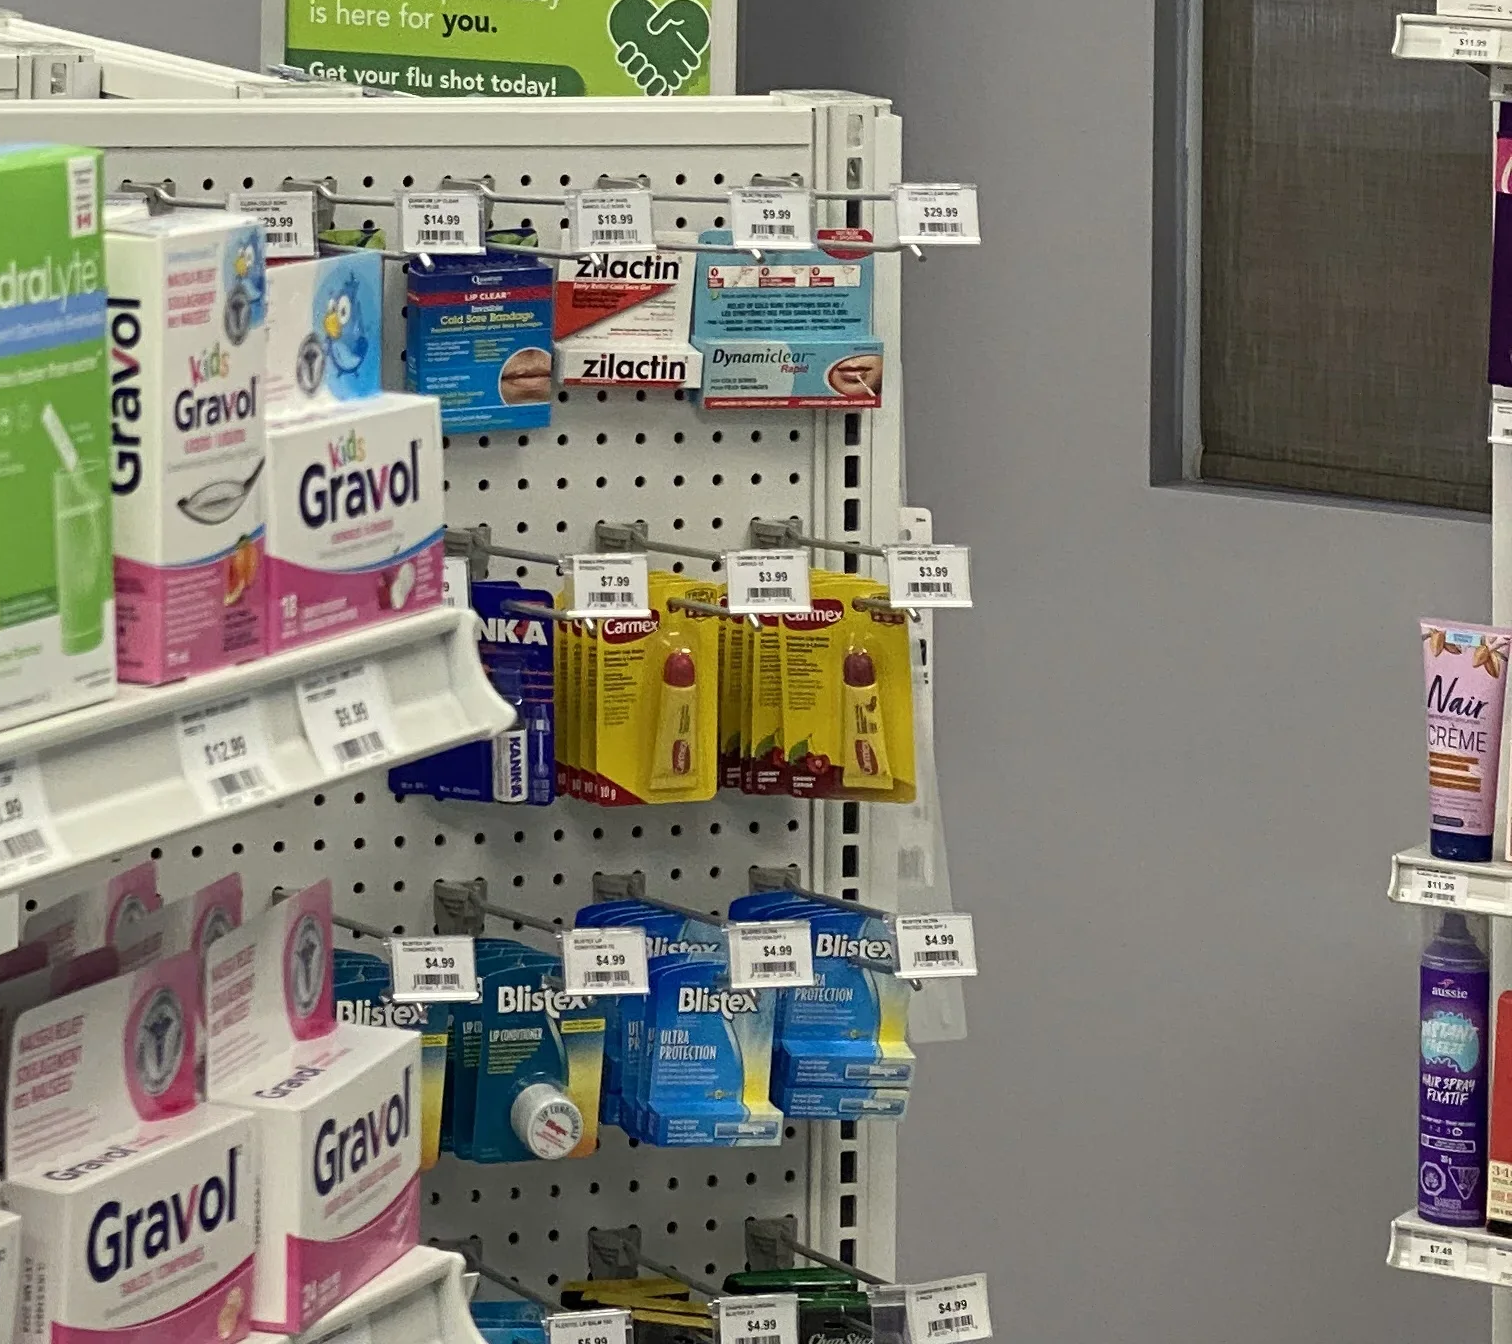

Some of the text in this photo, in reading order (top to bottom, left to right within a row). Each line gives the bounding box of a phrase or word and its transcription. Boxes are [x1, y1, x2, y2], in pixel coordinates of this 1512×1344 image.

[310, 0, 499, 38] is here for you.
[1459, 38, 1487, 47] $11.99
[309, 61, 558, 97] Get your flu shot today!
[423, 214, 461, 226] $14.99
[597, 213, 634, 226] $18.99
[762, 208, 791, 221] $9.99
[923, 206, 959, 218] $29.99
[575, 254, 679, 280] zilactin
[464, 291, 509, 302] LIP CLEAR
[440, 311, 535, 326] Cold Sore Bandage
[188, 340, 230, 388] kids
[712, 348, 807, 367] Dynamiclear
[581, 352, 686, 381] zilactin
[780, 364, 809, 375] Rapid
[107, 298, 143, 498] Gravol
[174, 374, 258, 433] Gravol
[327, 427, 367, 471] kids
[299, 438, 421, 530] Gravol
[758, 571, 788, 583] $3.99
[919, 566, 949, 578] $3.99
[600, 575, 630, 587] $7.99
[785, 608, 844, 624] Carmex
[477, 617, 549, 646] NKA
[604, 618, 659, 635] Carmex
[1427, 674, 1489, 721] Nair
[1428, 723, 1489, 754] CRÈME
[204, 735, 247, 765] $12.99
[508, 735, 522, 799] KANKA
[1427, 880, 1456, 892] $11.99
[816, 933, 895, 960] Blistex
[925, 934, 955, 946] $4.99
[763, 945, 793, 957] $4.99
[425, 957, 456, 969] $4.99
[596, 954, 626, 967] $4.99
[794, 986, 854, 1003] PROTECTION
[1431, 986, 1468, 999] aussie
[497, 985, 588, 1019] Blistex
[678, 987, 759, 1022] Blistex
[336, 999, 430, 1027] Blistex
[489, 1027, 543, 1043] LIP CONDITIONER
[660, 1029, 690, 1046] ULTRA
[659, 1045, 717, 1061] PROTECTION
[1421, 1072, 1476, 1093] HAIR SPRAY
[1426, 1087, 1470, 1106] FIXATIF
[313, 1064, 413, 1197] Gravol
[43, 1144, 140, 1182] Gravol
[87, 1145, 238, 1284] Gravol
[937, 1299, 968, 1315] $4.99
[746, 1318, 777, 1332] $4.99
